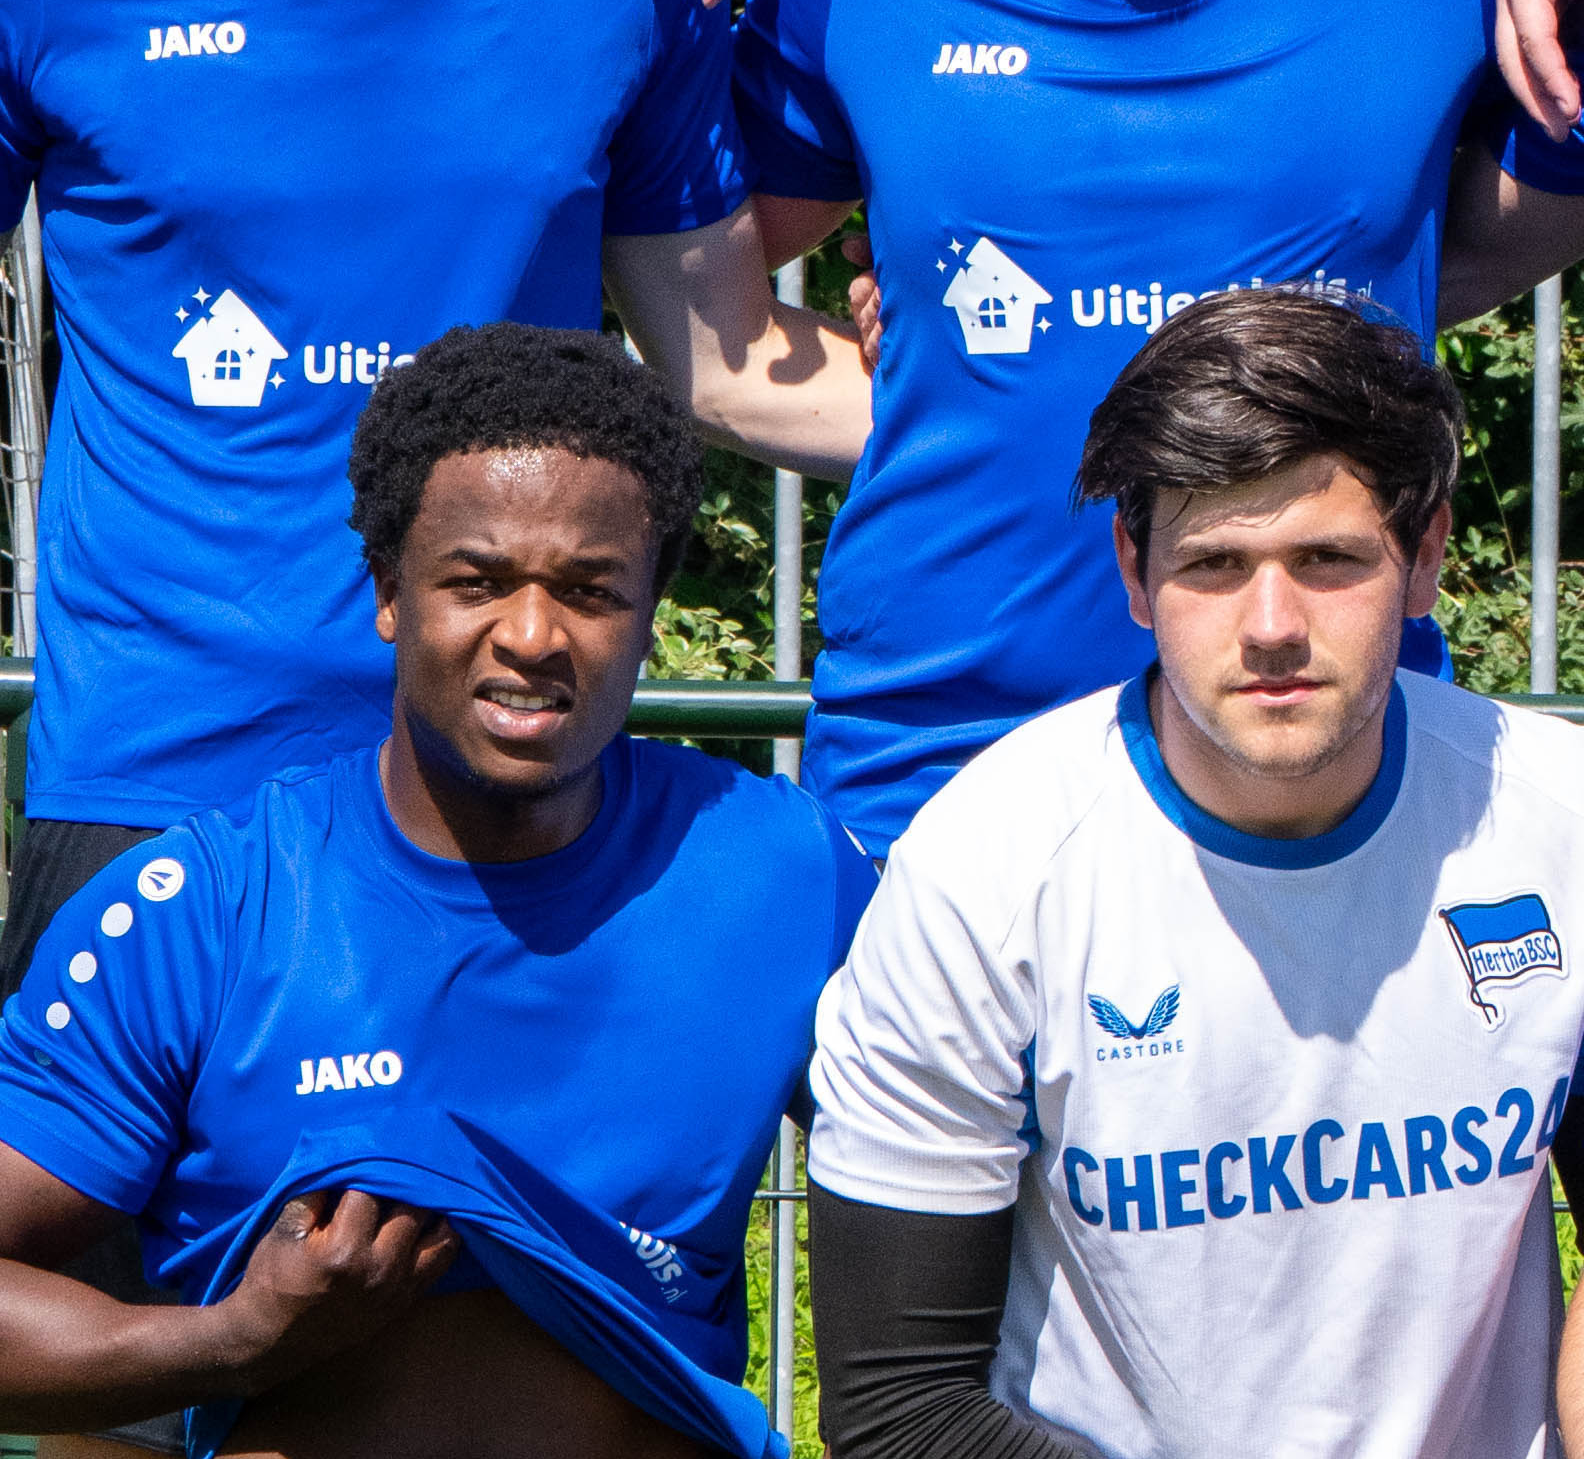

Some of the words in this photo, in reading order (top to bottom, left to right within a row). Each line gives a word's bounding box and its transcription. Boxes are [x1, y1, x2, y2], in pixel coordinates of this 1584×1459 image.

[145, 21, 246, 61] JAKO
[932, 43, 1029, 76] JAKO
[1096, 1039, 1185, 1061] CASTORE
[295, 1049, 403, 1095] JAKO
[1062, 1074, 1570, 1233] CHECKCARS24
